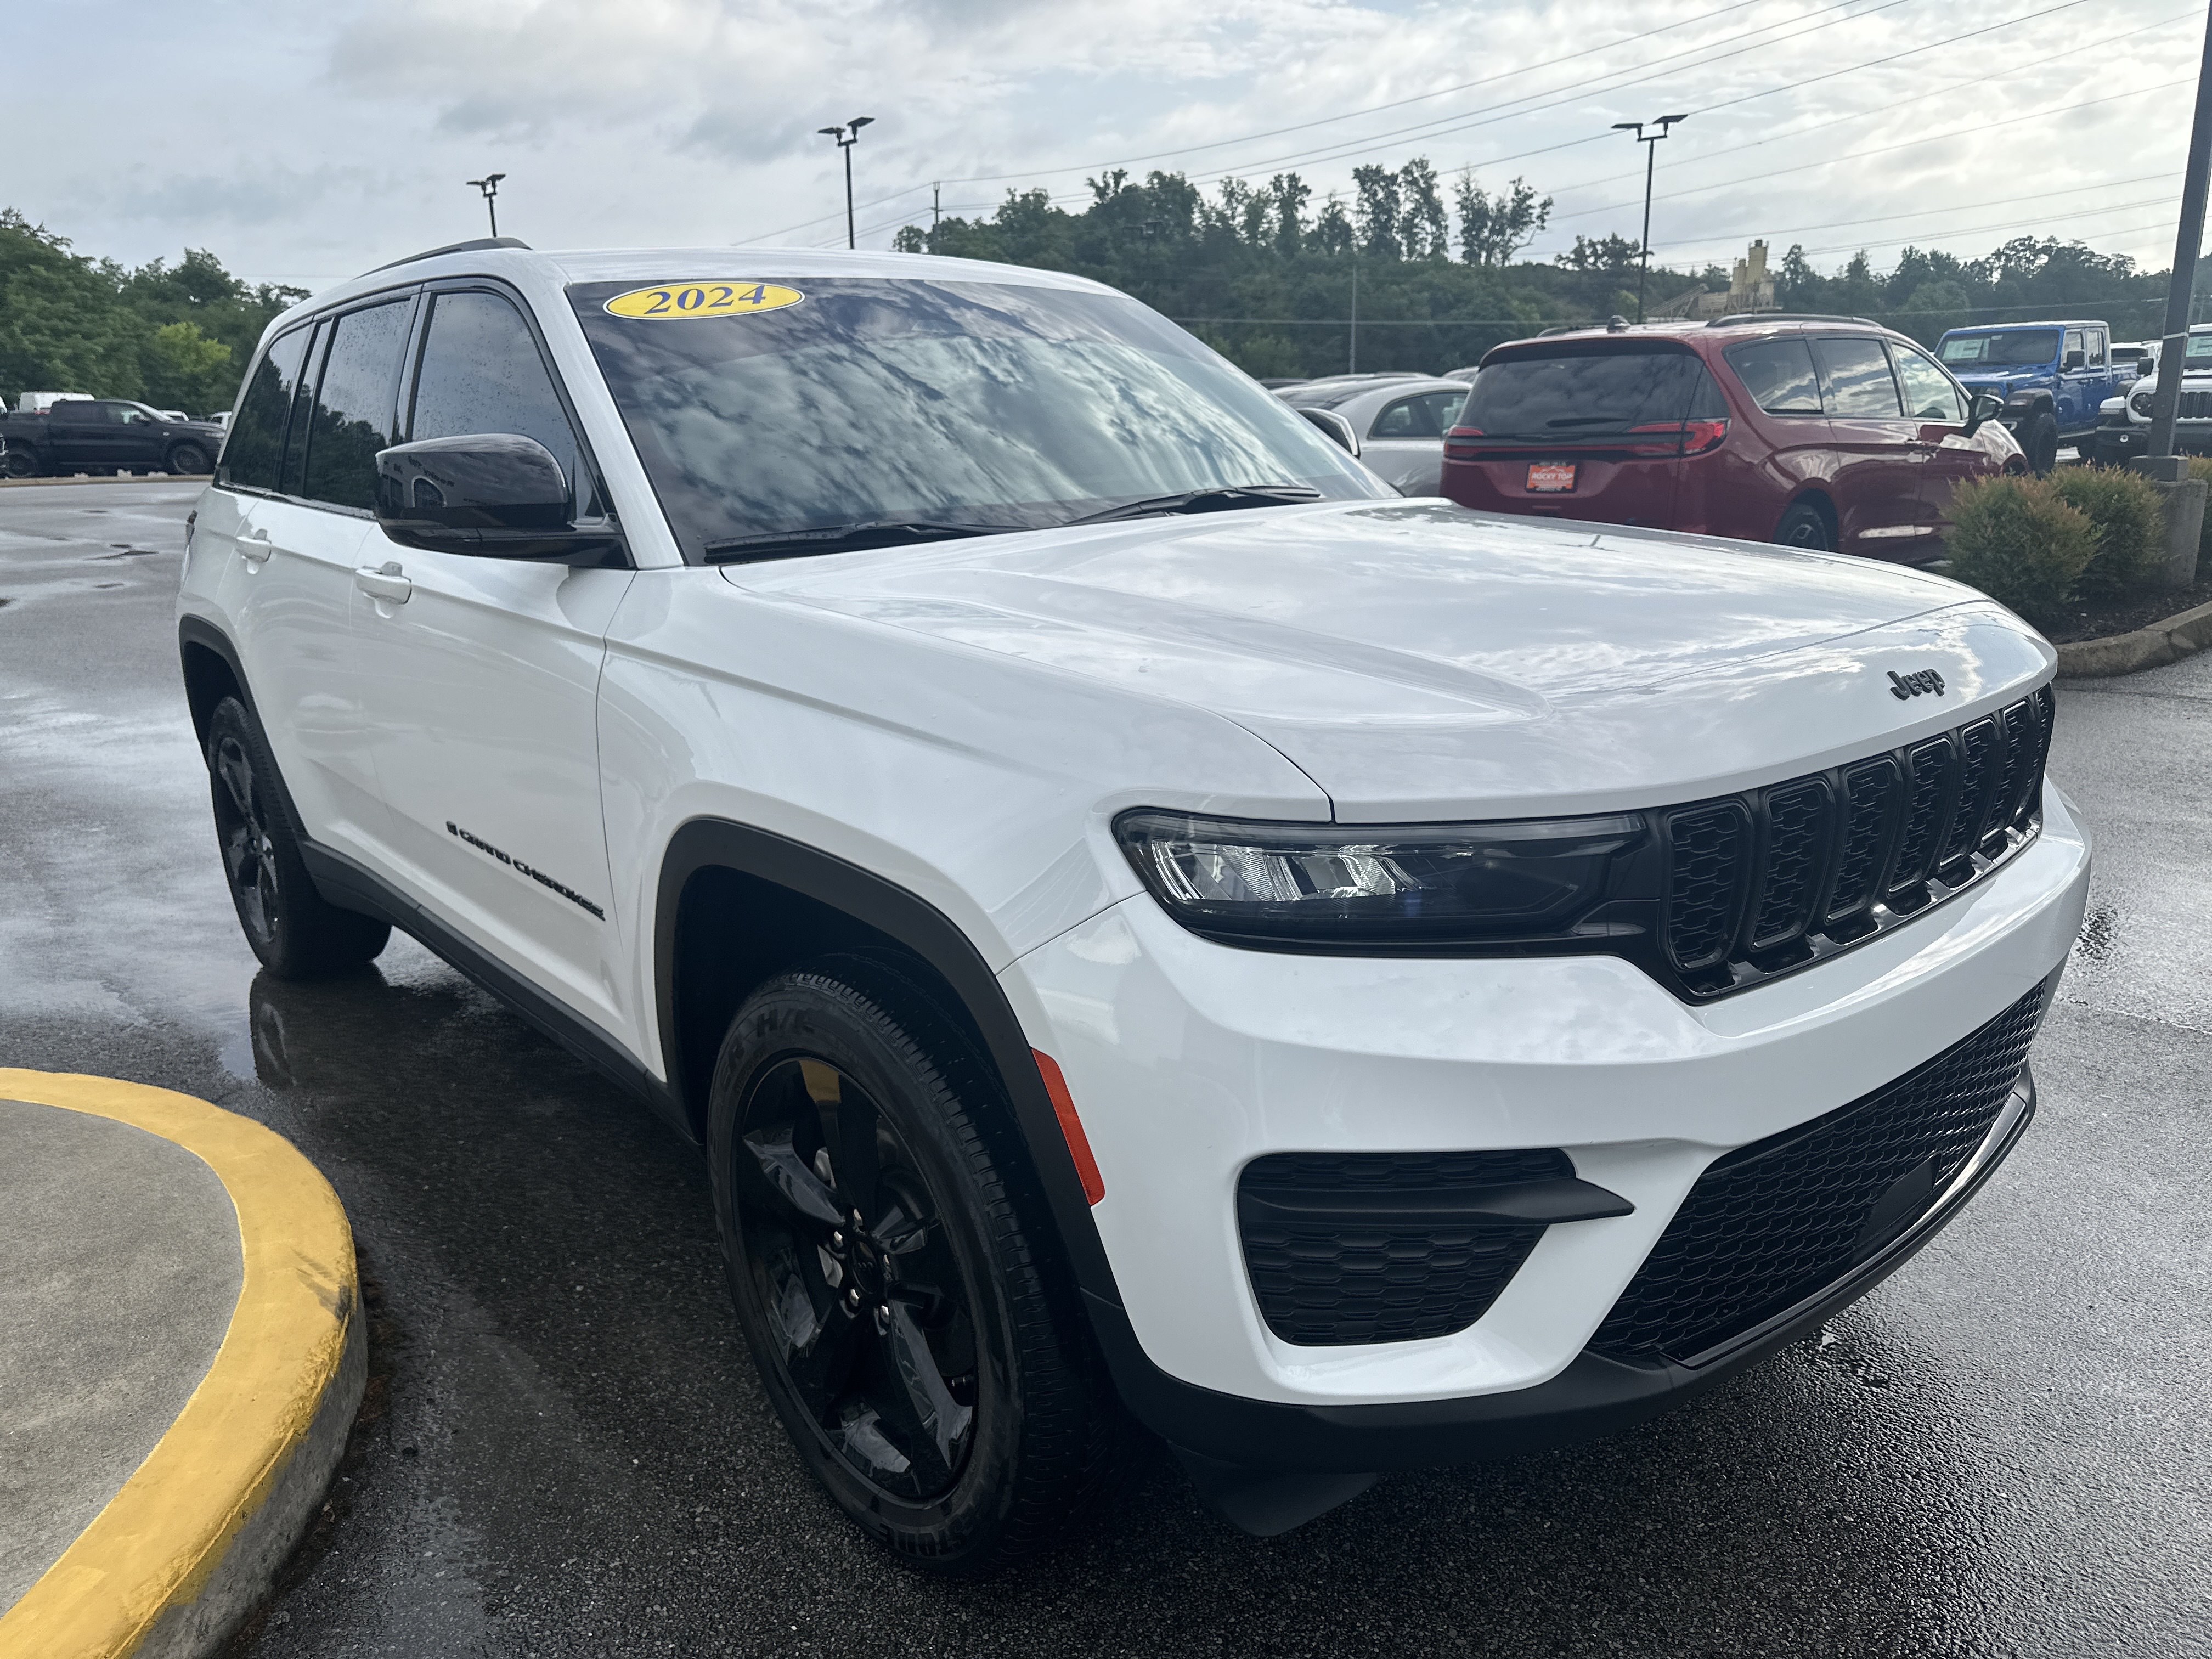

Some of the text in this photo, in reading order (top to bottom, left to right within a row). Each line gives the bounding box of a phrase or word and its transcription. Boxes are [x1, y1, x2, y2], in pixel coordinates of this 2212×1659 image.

[644, 284, 766, 314] 2024
[1887, 668, 1945, 700] Jeep
[459, 828, 606, 922] GRAND CHEROKEE
